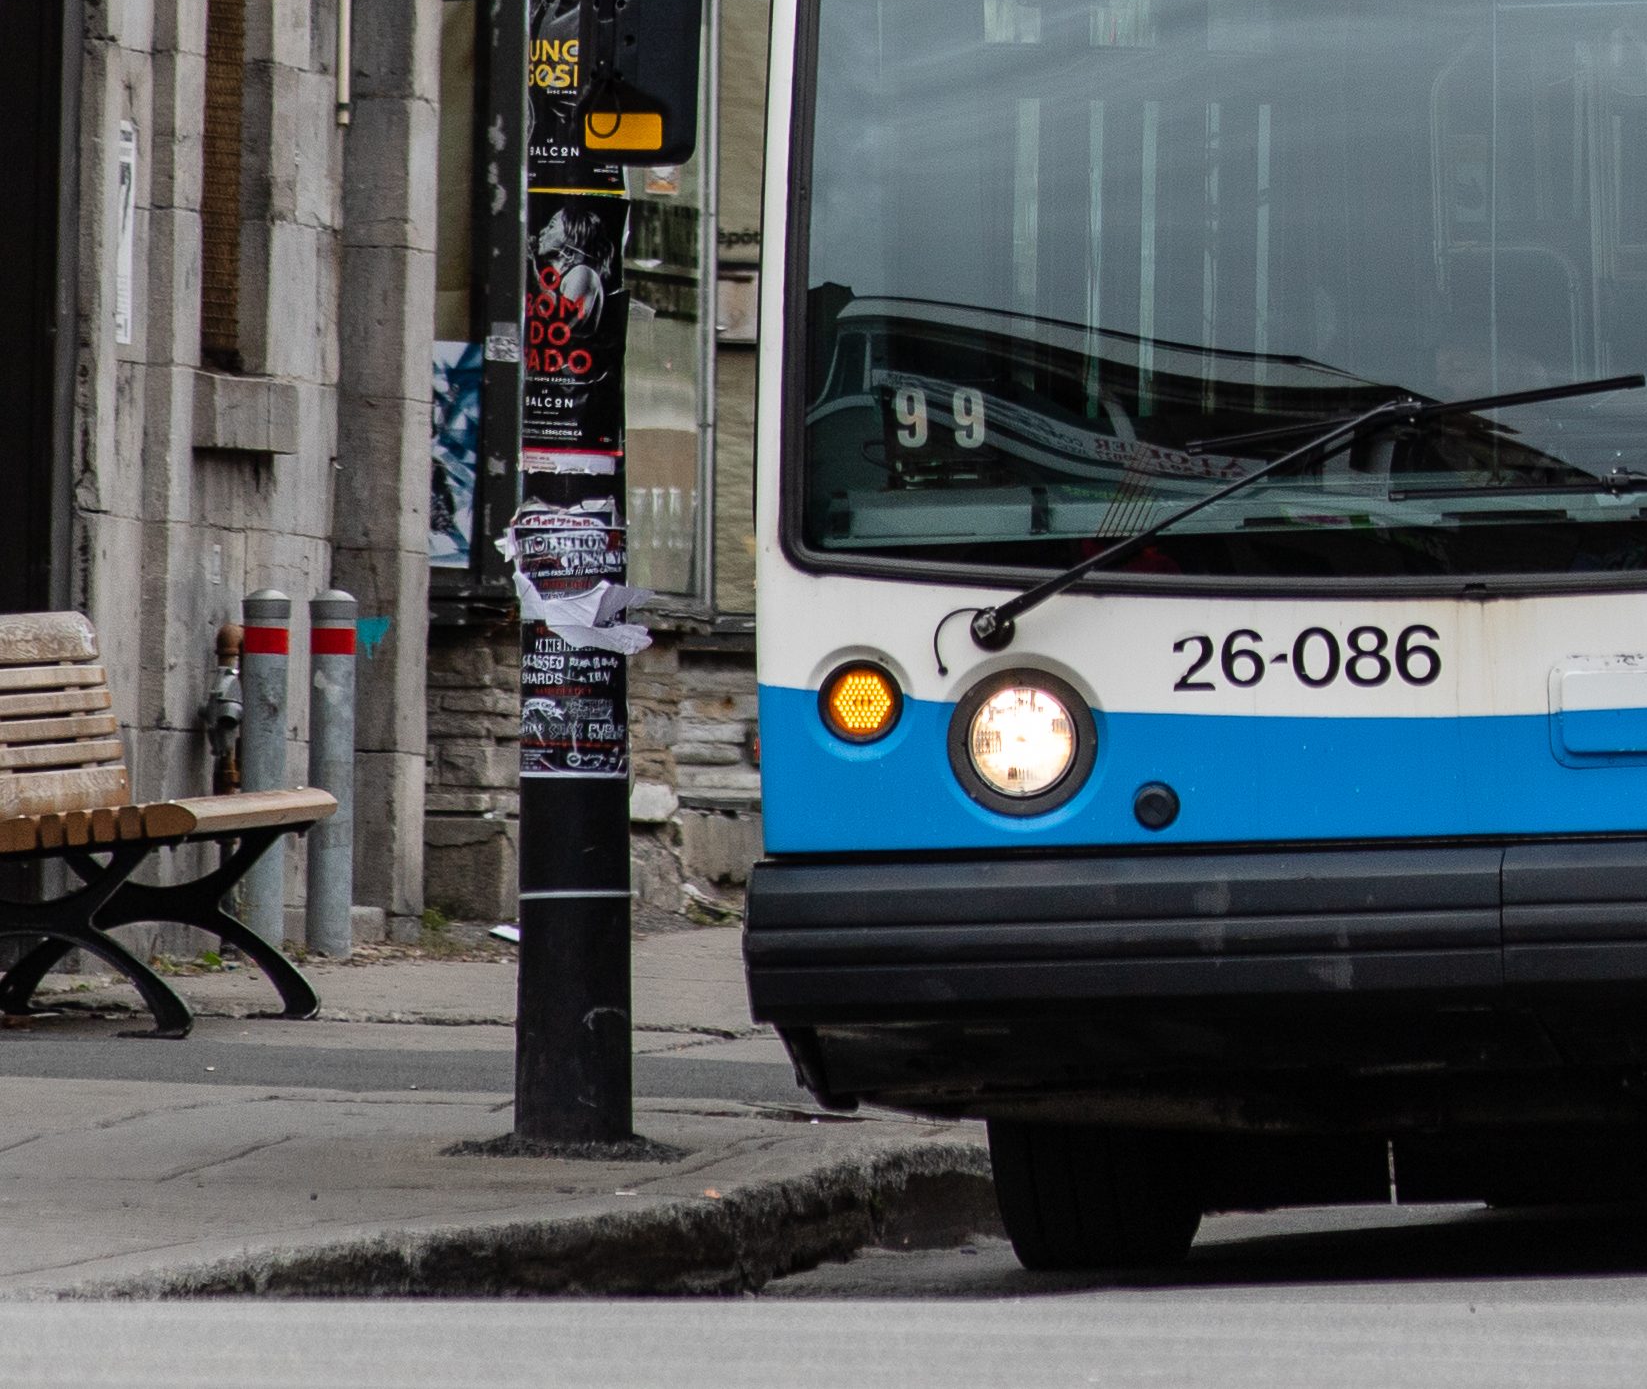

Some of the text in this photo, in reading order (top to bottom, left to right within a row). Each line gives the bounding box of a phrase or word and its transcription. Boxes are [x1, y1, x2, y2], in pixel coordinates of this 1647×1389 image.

[718, 227, 760, 249] épôt
[539, 266, 561, 291] O
[530, 322, 571, 345] DO
[526, 349, 593, 375] ADO
[1173, 624, 1442, 692] 26-086
